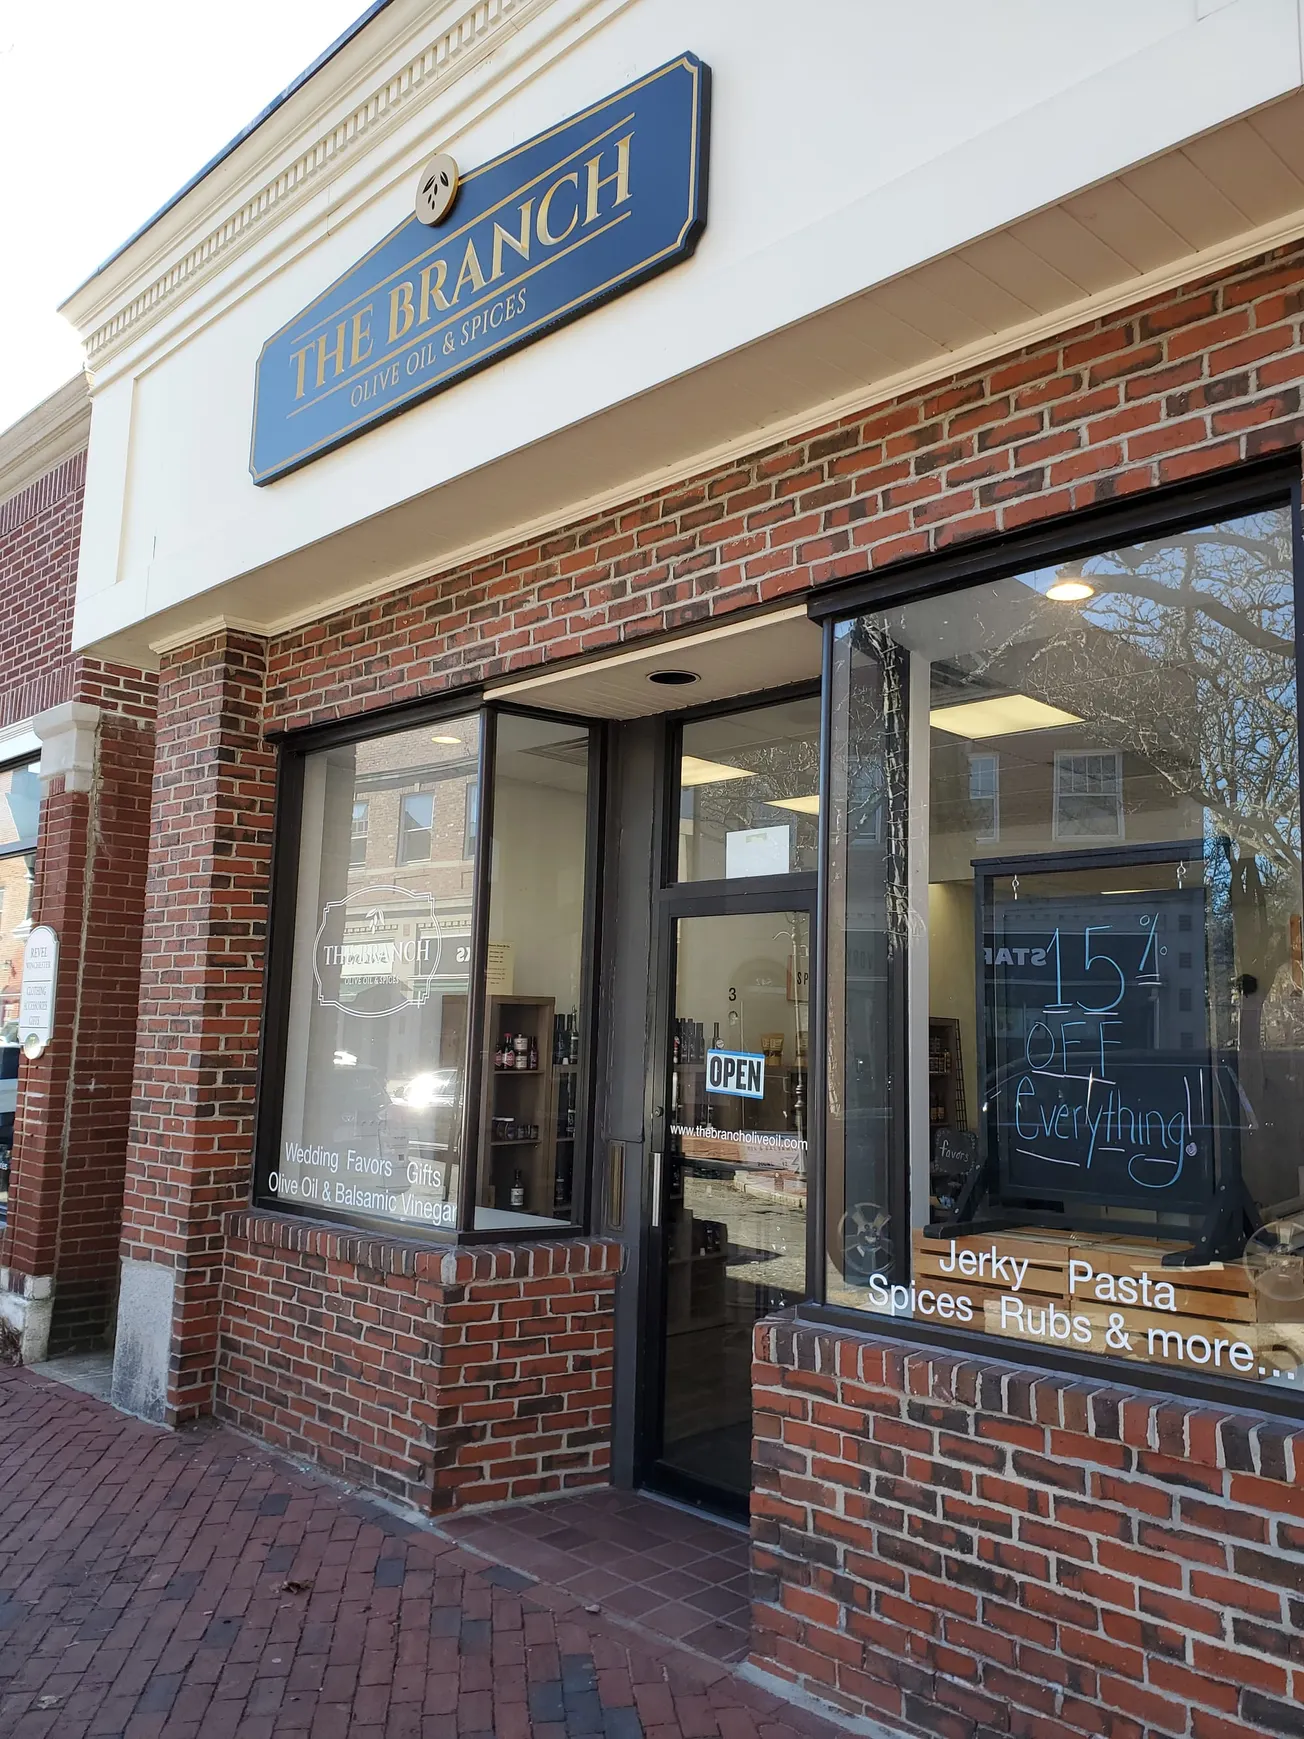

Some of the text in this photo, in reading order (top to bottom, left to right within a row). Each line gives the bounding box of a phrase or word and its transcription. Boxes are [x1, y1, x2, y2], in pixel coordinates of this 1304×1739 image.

[289, 130, 635, 401] THE BRANCH
[351, 287, 527, 408] OLIVE OIL & SPICES
[1045, 913, 1168, 1012] 15%
[729, 987, 737, 1002] 3
[710, 1056, 762, 1093] OPEN
[1027, 1021, 1123, 1078] OFF
[285, 1141, 441, 1188] Wedding Favors Gifts
[670, 1124, 808, 1150] www.thebrancholiveoil.com
[268, 1171, 458, 1226] Olive Oil & Balsamic Vinegar
[939, 1240, 1177, 1311] Jerky Pasta
[868, 1273, 1295, 1381] Spices Rubs & more...
